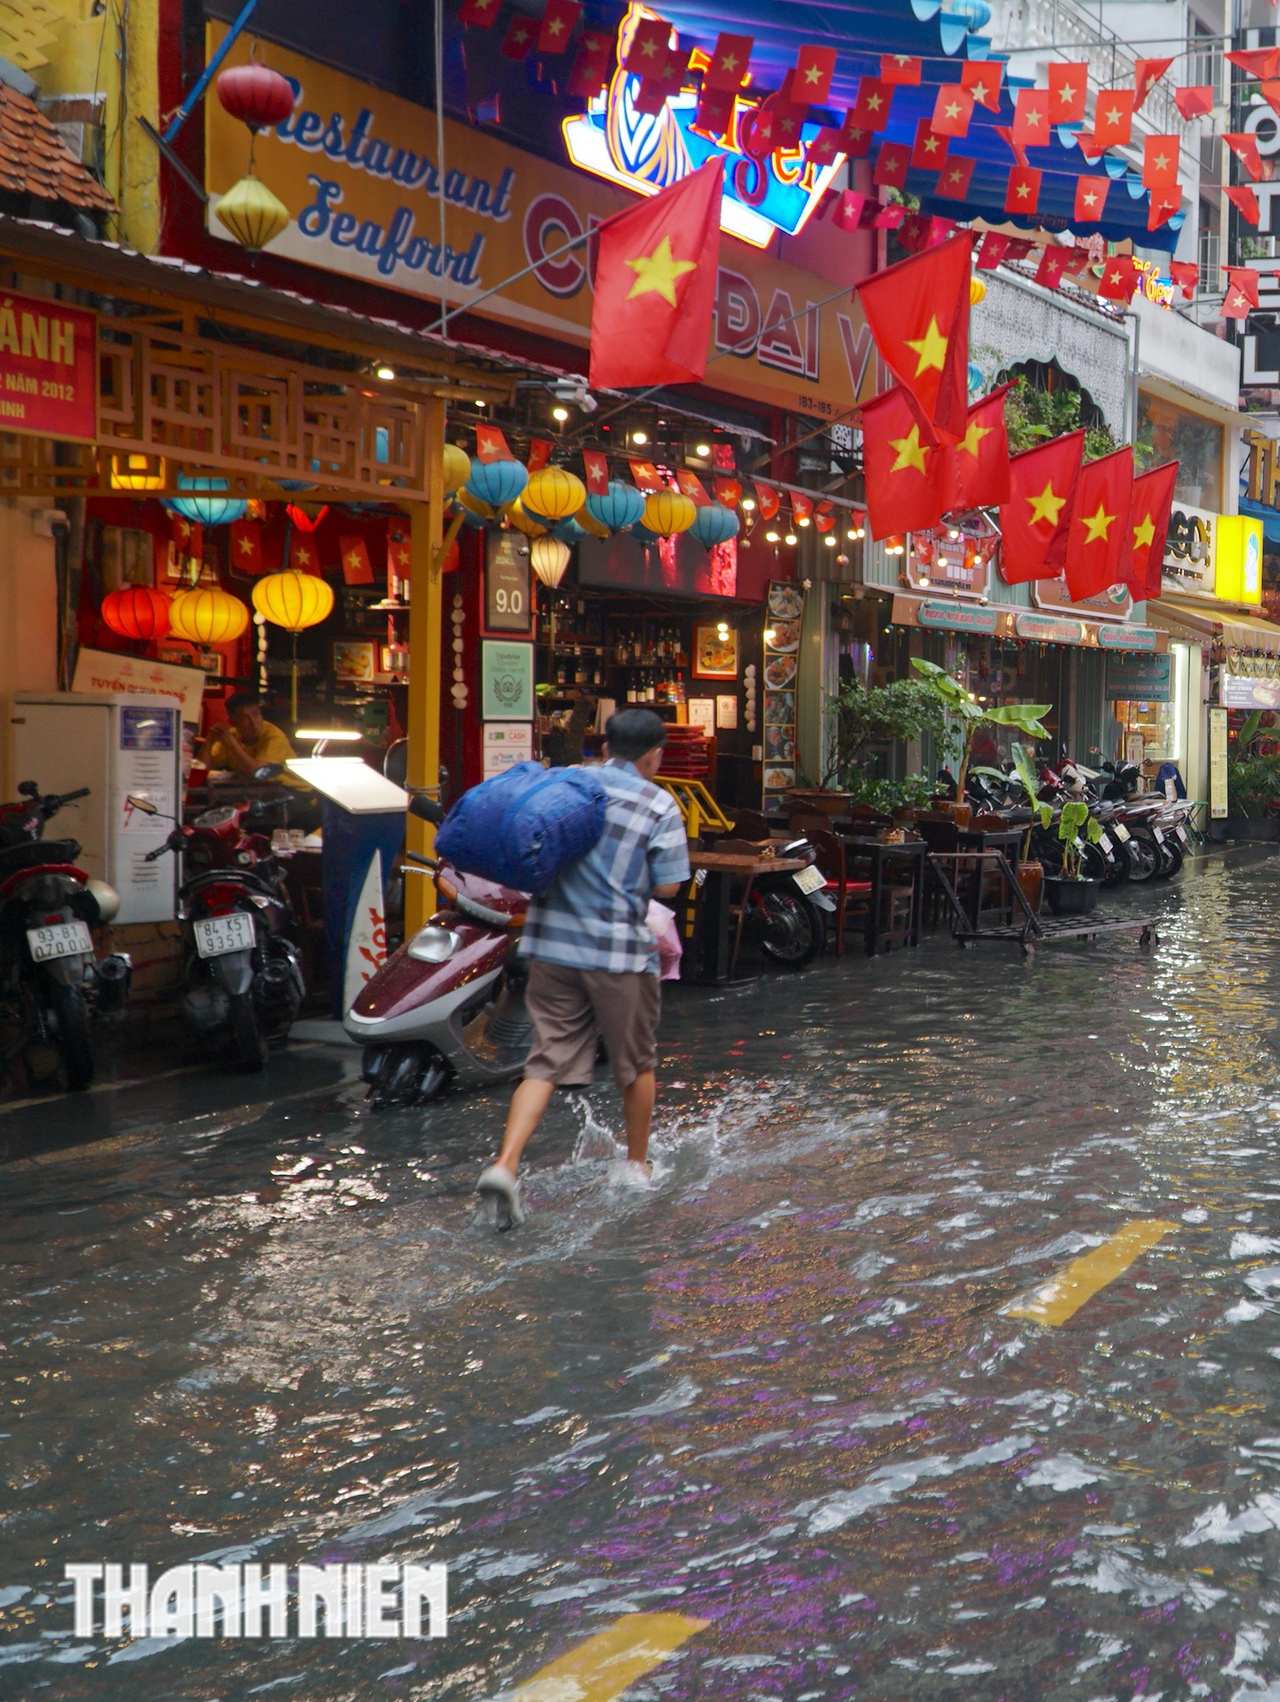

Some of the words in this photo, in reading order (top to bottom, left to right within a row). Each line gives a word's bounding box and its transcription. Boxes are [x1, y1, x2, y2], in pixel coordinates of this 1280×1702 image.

[297, 173, 484, 288] Seafood
[5, 372, 38, 395] NĂM
[41, 380, 74, 402] 2012
[0, 400, 26, 419] INH
[496, 588, 522, 614] 9.0
[508, 732, 526, 740] CASH
[37, 926, 78, 943] 93-B1
[206, 933, 244, 951] 9351
